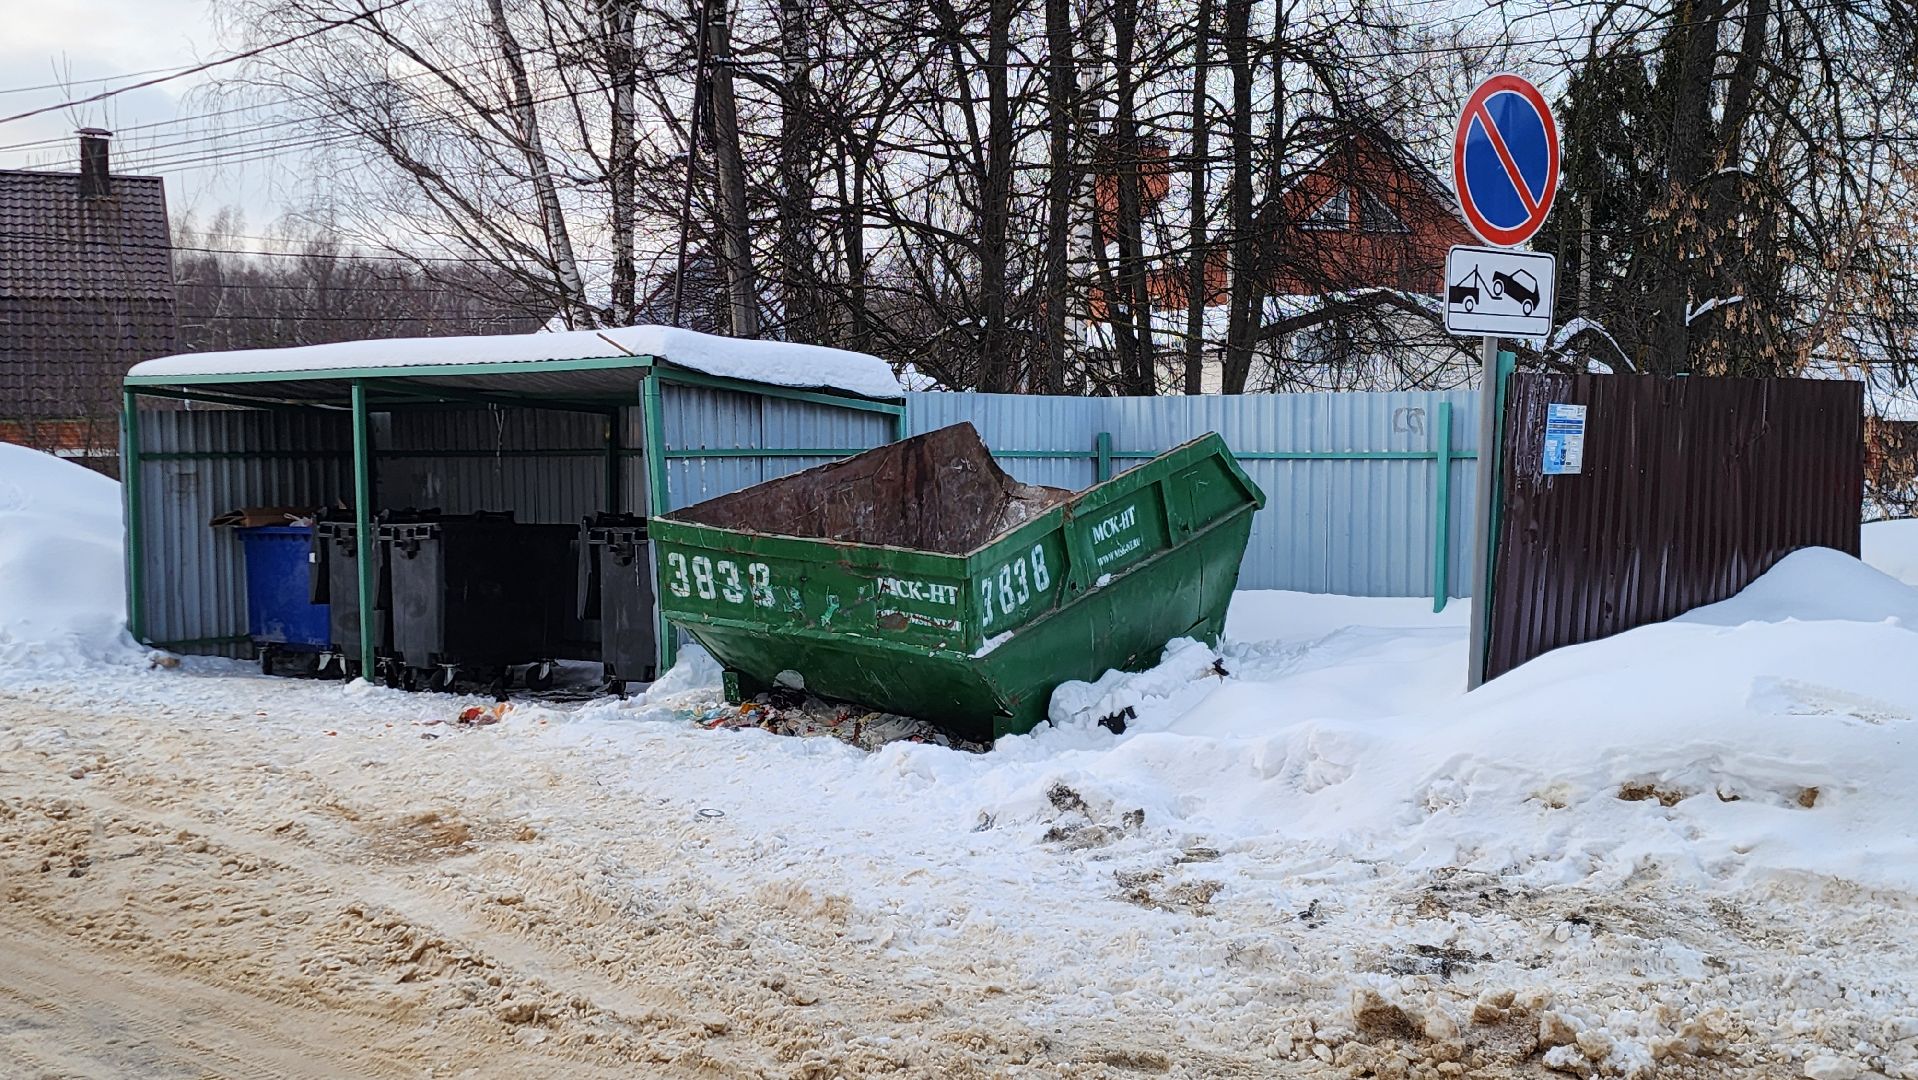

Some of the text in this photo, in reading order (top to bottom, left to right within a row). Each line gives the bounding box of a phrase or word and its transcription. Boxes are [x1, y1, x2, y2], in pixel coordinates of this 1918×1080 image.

[1092, 504, 1136, 545] МСК-НТ
[667, 552, 776, 607] 3838
[877, 577, 958, 605] МСК-НТ
[982, 543, 1050, 627] 3838
